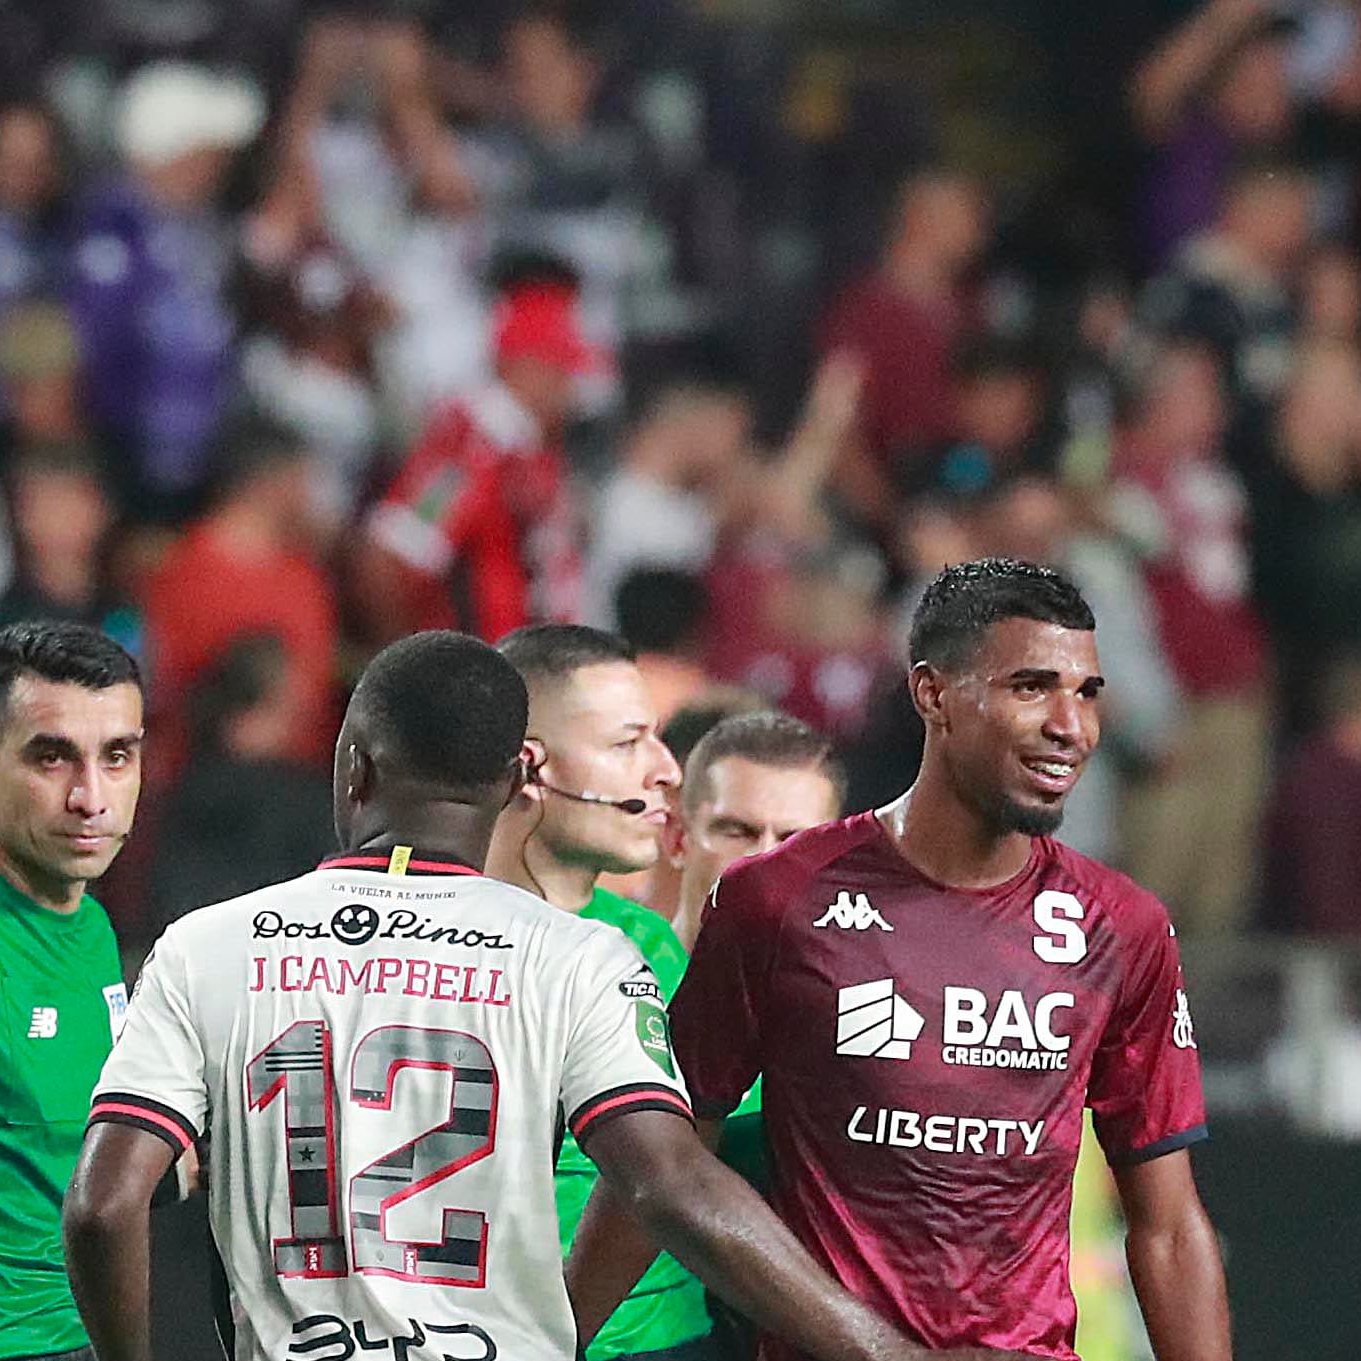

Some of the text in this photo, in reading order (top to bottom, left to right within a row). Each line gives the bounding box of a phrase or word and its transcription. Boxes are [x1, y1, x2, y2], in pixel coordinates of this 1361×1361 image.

[350, 885, 392, 899] VUELTA
[252, 909, 515, 950] Dos Pinos
[1033, 889, 1088, 963] S
[249, 955, 512, 1007] J.CAMPBELL
[624, 982, 662, 998] TICA
[943, 986, 1076, 1051] BAC
[941, 1045, 1069, 1070] CREDOMATIC
[246, 1019, 500, 1289] 12
[846, 1105, 1046, 1156] LIBERTY
